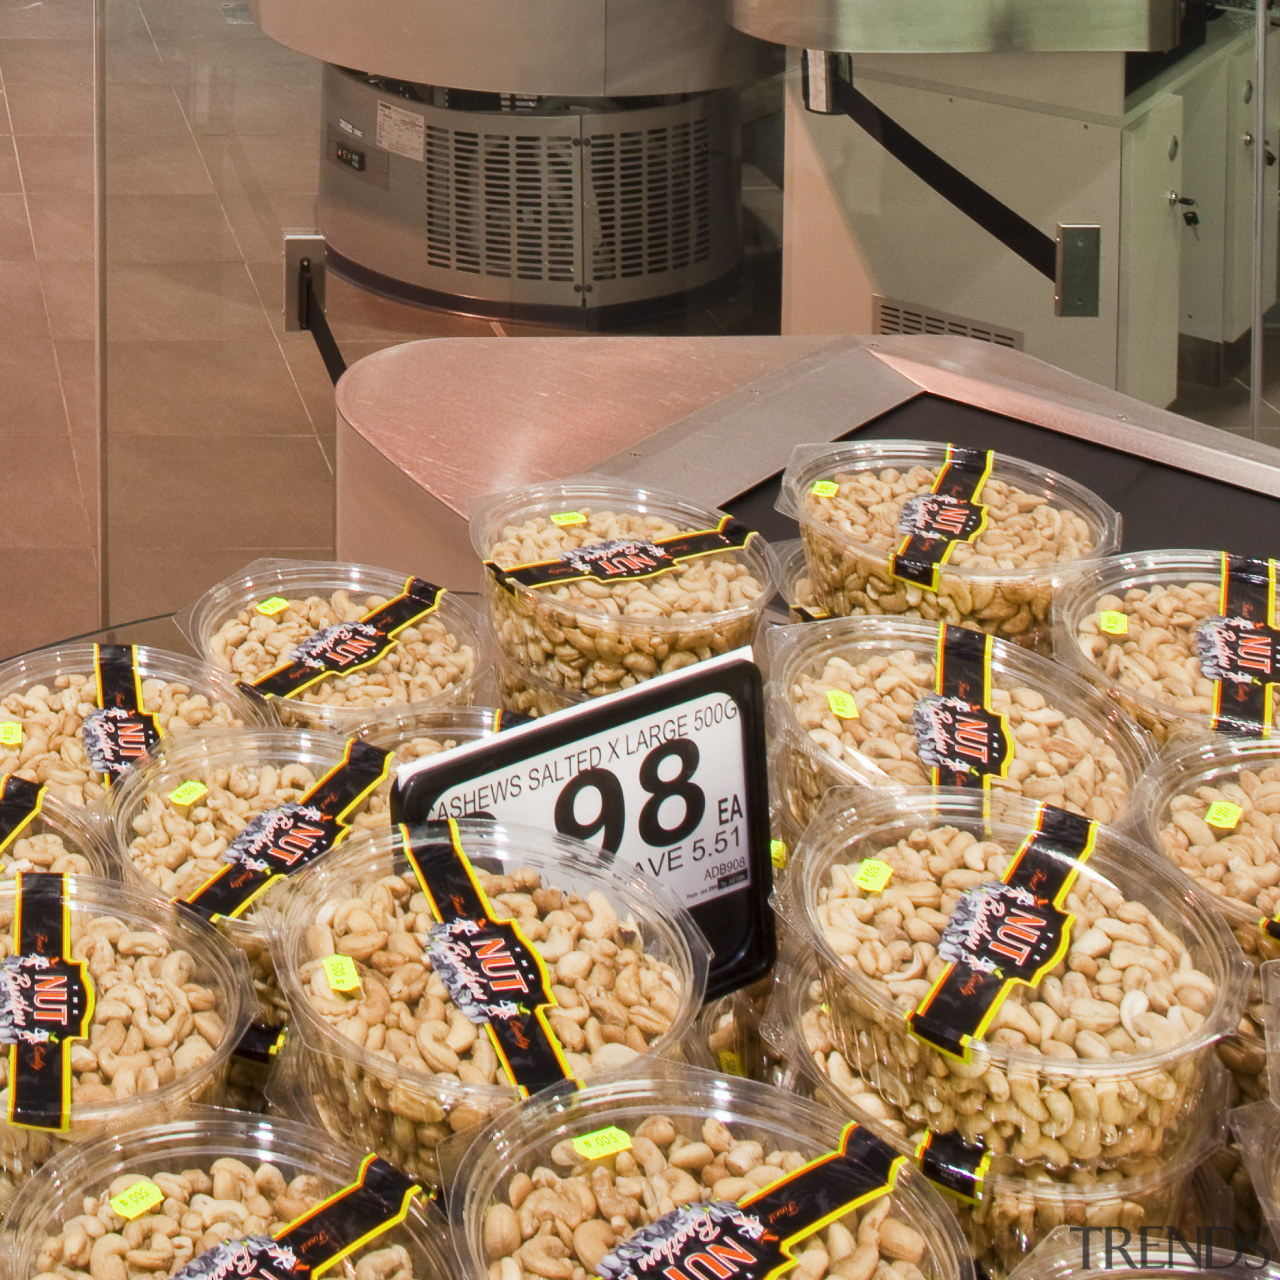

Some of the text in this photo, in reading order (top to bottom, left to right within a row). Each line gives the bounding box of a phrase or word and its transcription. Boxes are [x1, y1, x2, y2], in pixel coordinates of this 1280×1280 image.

[933, 506, 969, 534] NUT
[599, 553, 657, 575] NUT
[327, 635, 377, 666] NUT
[1237, 633, 1272, 674] NUT
[432, 697, 738, 822] ASHEWS SALTED X LARGE 500G
[955, 715, 988, 763] NUT
[718, 793, 744, 827] EA
[268, 822, 325, 866] NUT
[692, 825, 741, 862] 5.51
[704, 856, 746, 881] ADB908
[988, 908, 1047, 966] NUT
[471, 938, 529, 994] NUT
[34, 974, 67, 1026] NUT
[636, 1212, 722, 1272] Brothers
